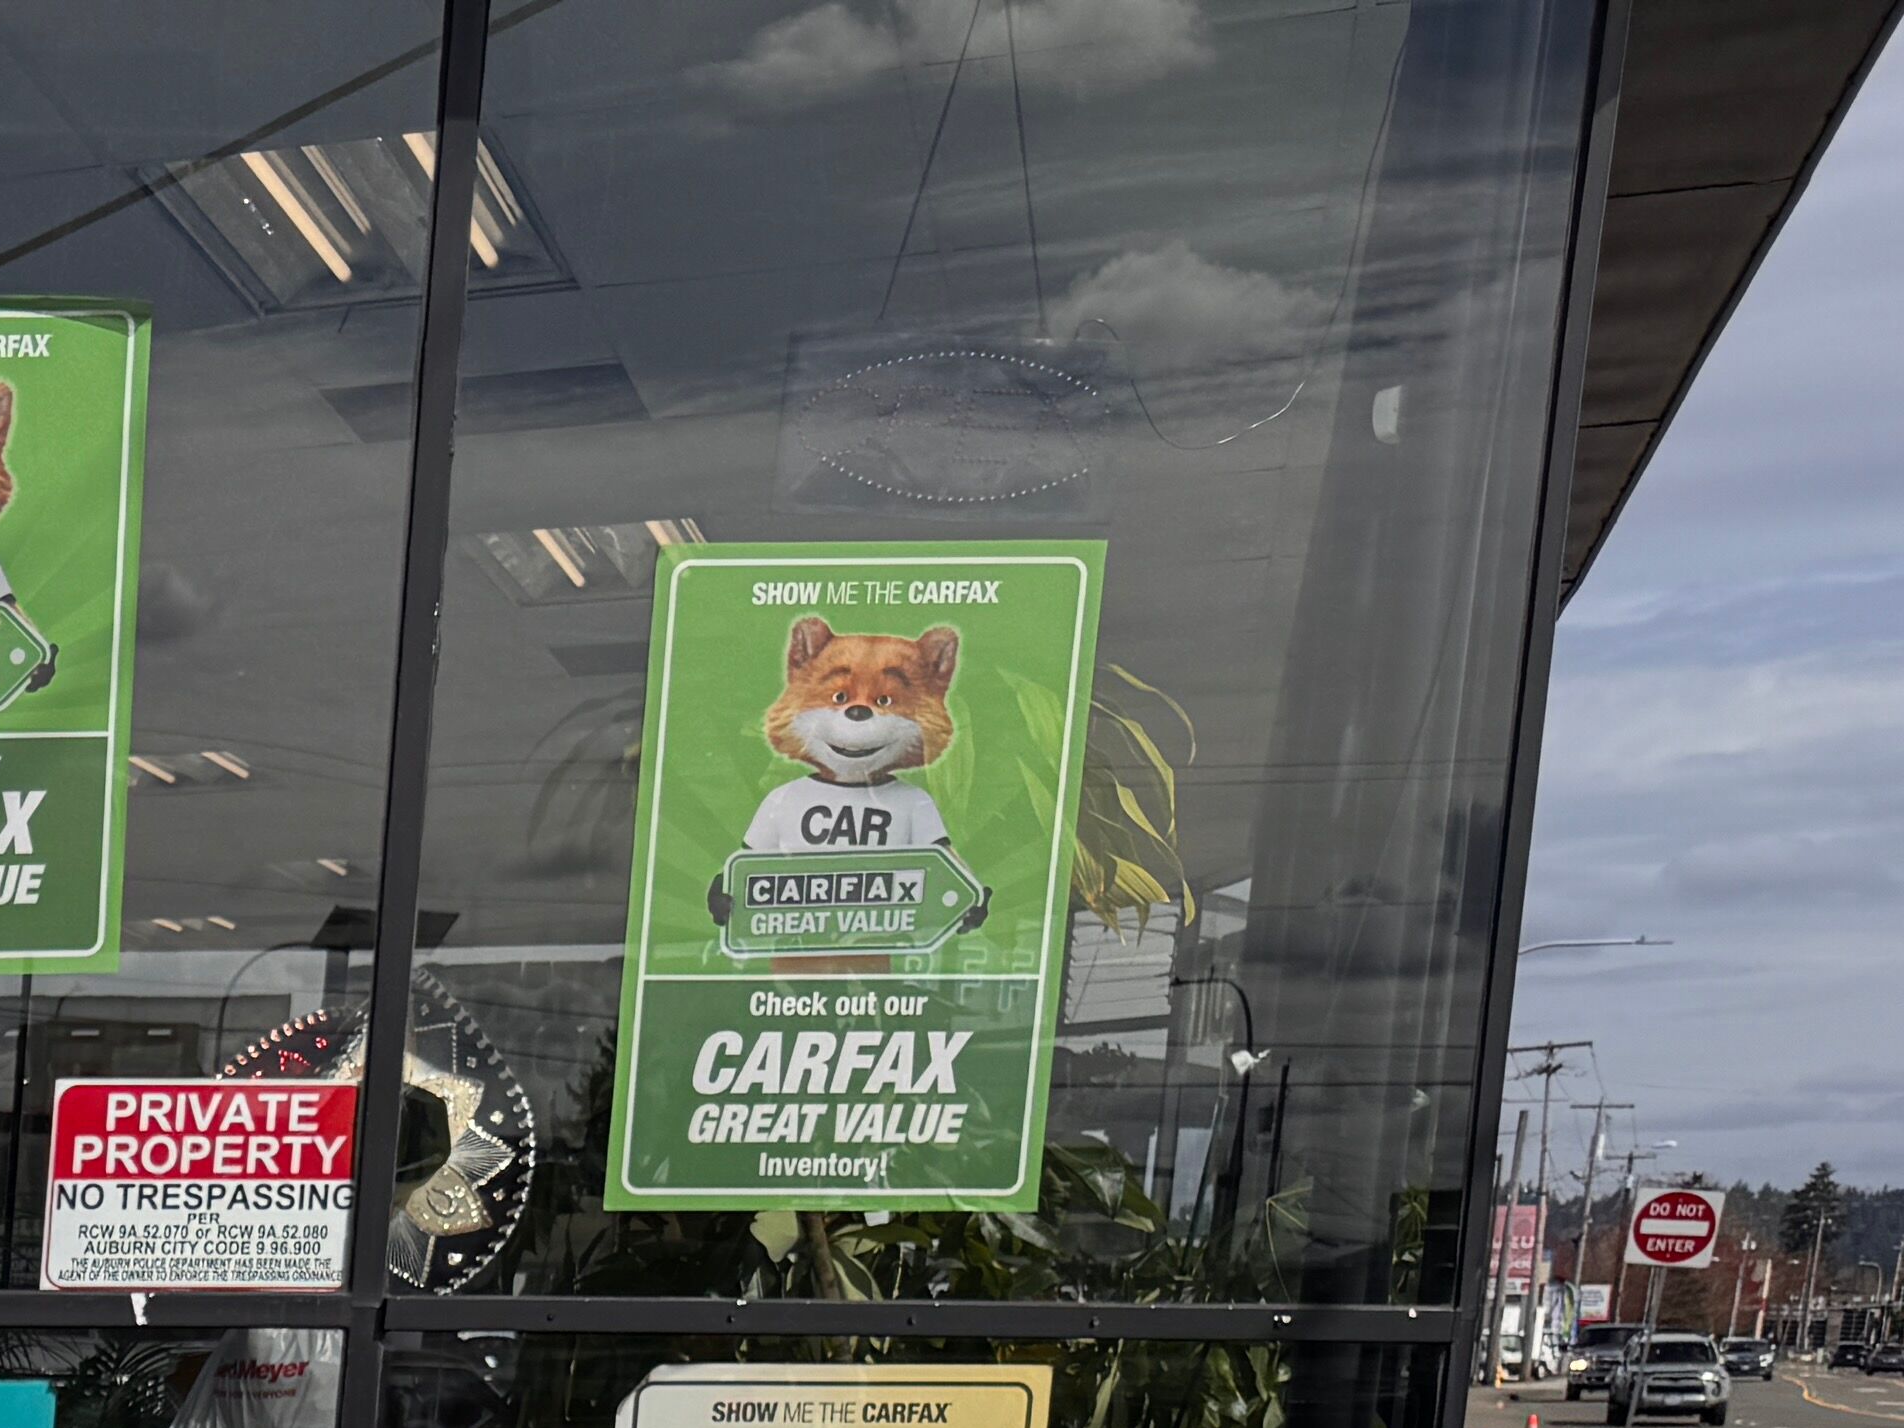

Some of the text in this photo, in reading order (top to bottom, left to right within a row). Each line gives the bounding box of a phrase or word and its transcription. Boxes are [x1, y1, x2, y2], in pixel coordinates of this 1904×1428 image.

[692, 1030, 974, 1095] CARFAX
[106, 1092, 320, 1133] PRIVATE
[687, 1103, 968, 1144] GREAT VALUE
[72, 1135, 347, 1175] PROPERTY
[758, 1152, 887, 1182] Inventory!
[56, 1183, 356, 1211] NO TRESPASSING
[187, 1212, 220, 1225] PER
[1649, 1202, 1706, 1217] DO NOT
[78, 1225, 328, 1239] RCW 9A.52.070 or RCW 9A.52.080
[84, 1241, 321, 1255] AUBURN CITY CODE 9.96.900
[1646, 1238, 1695, 1253] ENTER
[71, 1258, 332, 1269] THE AUBURN POLICE DEPARTMENT HAS BEEN MADE THE
[58, 1270, 87, 1281] AGENT
[89, 1270, 103, 1281] OF
[104, 1270, 120, 1281] THE
[121, 1270, 154, 1281] OWNER
[155, 1270, 167, 1281] TO
[169, 1270, 210, 1281] ENFORCE
[212, 1270, 228, 1281] THE
[230, 1270, 290, 1281] TRESPASSING
[711, 1401, 949, 1424] SHOW ME THE CARFAX
